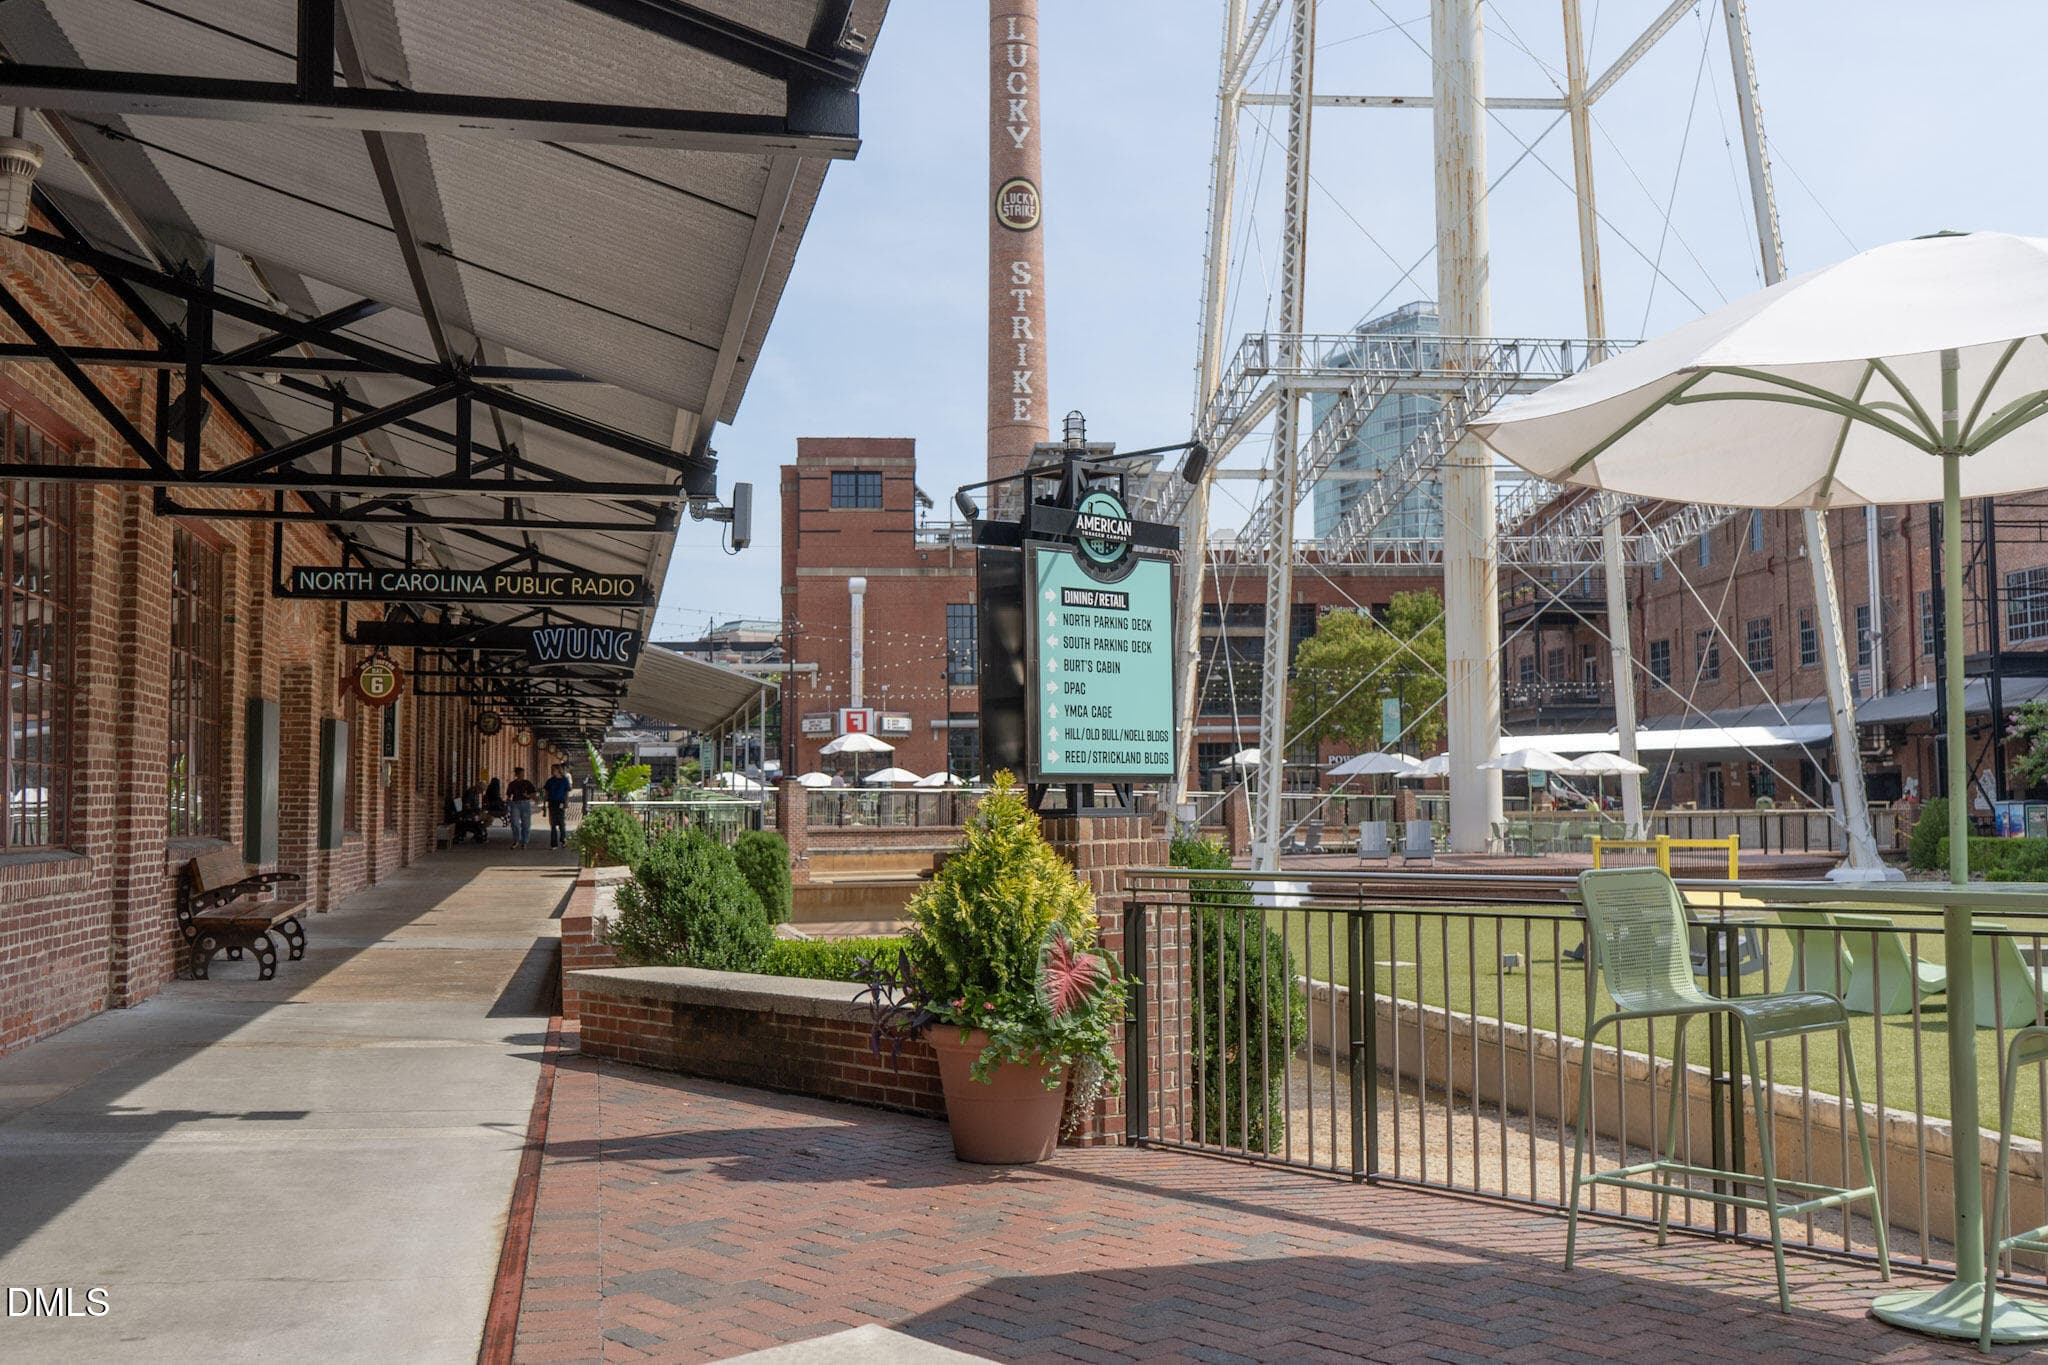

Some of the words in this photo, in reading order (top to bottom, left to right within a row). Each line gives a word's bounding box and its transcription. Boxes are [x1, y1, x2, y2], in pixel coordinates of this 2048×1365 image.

[1006, 17, 1031, 149] LUCKY
[1003, 192, 1035, 206] LUCKY
[1003, 204, 1036, 218] STRIKE
[1010, 260, 1034, 421] STRIKE
[1076, 514, 1132, 537] AMERICAN
[300, 571, 373, 591] NORTH
[380, 573, 489, 594] CAROLINA
[494, 575, 565, 596] PUBLIC
[571, 577, 636, 597] RADIO
[1064, 590, 1127, 608] DINING/RETAIL
[1063, 613, 1091, 628] NORTH
[1094, 615, 1129, 630] PARKING
[1131, 618, 1152, 632] DECK
[532, 627, 633, 663] WUNC
[1063, 636, 1091, 650] SOUTH
[1094, 638, 1129, 652] PARKING
[1131, 640, 1152, 654] DECK
[1064, 659, 1093, 673] BURT'S
[1096, 660, 1121, 674] CABIN
[371, 676, 384, 694] 6
[1064, 681, 1086, 695] DPAC
[1064, 704, 1089, 718] YMCA
[1091, 705, 1113, 719] CAGE
[1065, 728, 1100, 741] HILL/OLD
[1146, 730, 1169, 743] BLDGS
[1065, 750, 1141, 764] REED/STRICKLAND
[1144, 752, 1169, 765] BLDGS
